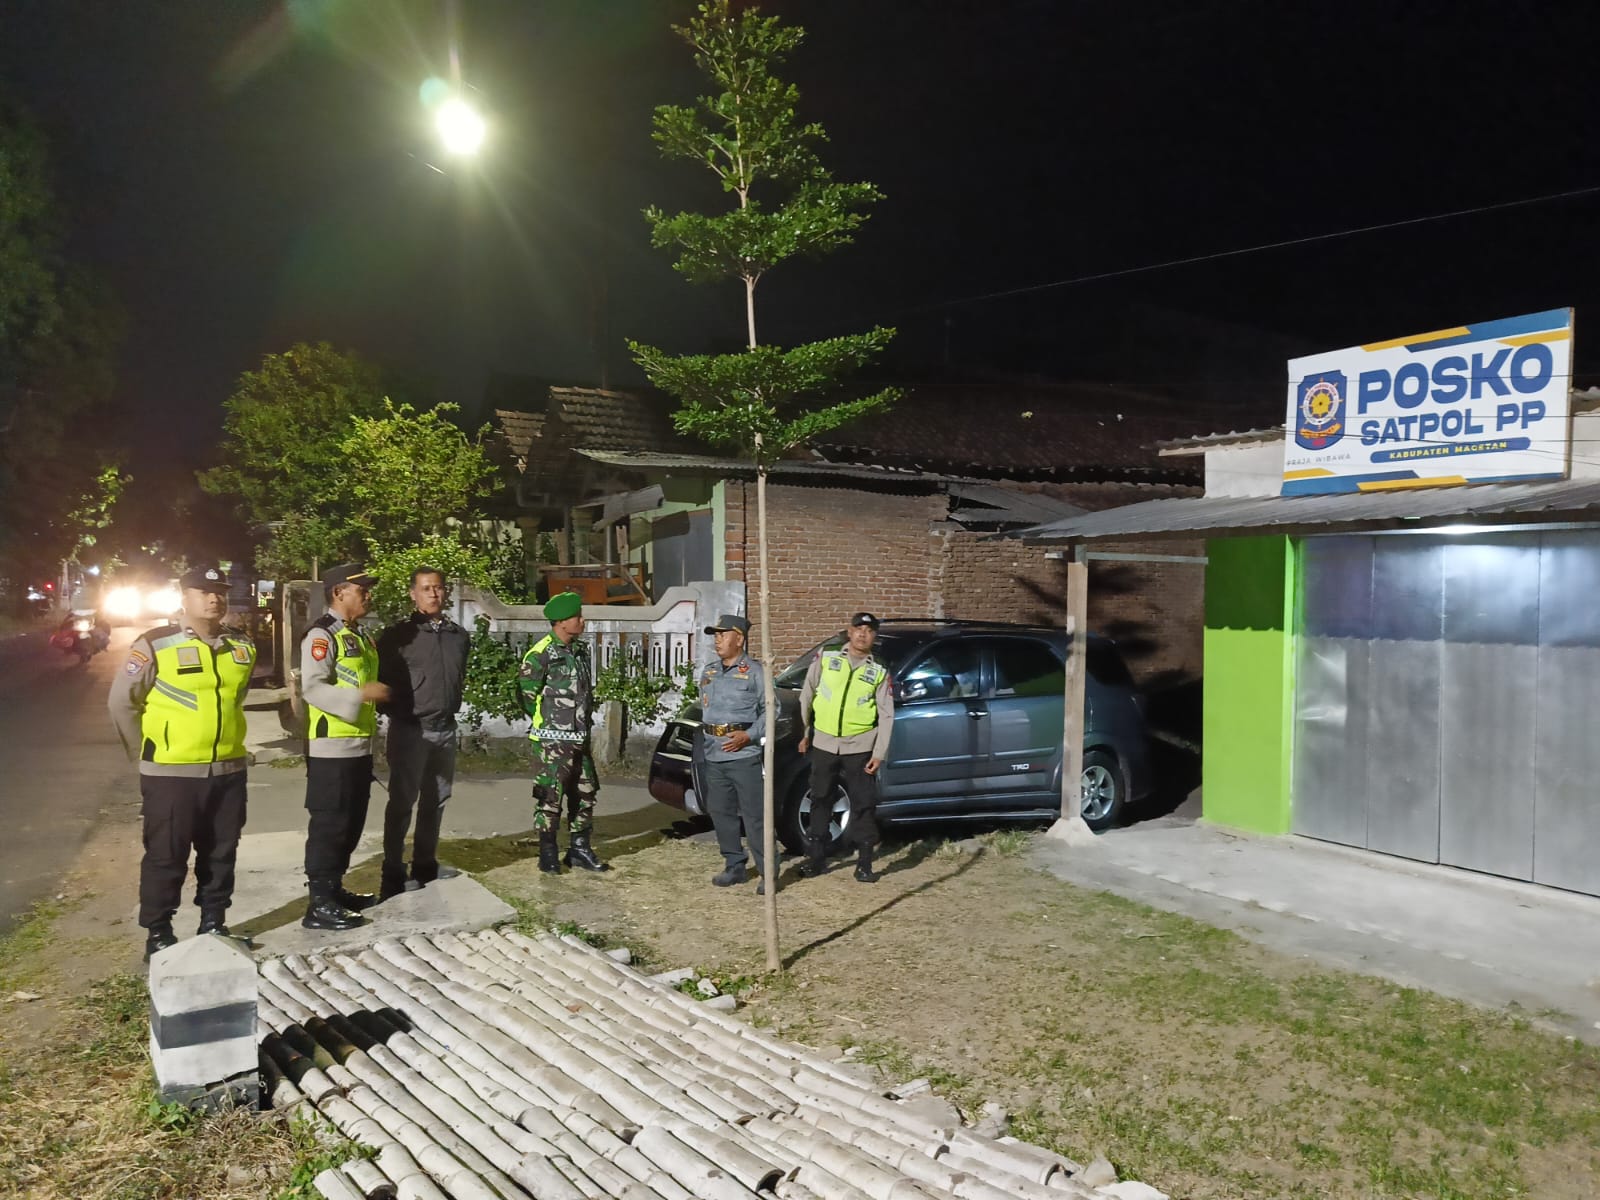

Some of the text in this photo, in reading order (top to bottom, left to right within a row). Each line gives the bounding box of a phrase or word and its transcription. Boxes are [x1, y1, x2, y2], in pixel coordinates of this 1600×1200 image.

[1358, 343, 1553, 414] POSKO
[1360, 408, 1483, 446] SATPOL
[1496, 400, 1546, 431] PP
[1389, 447, 1449, 459] KABUPATEN
